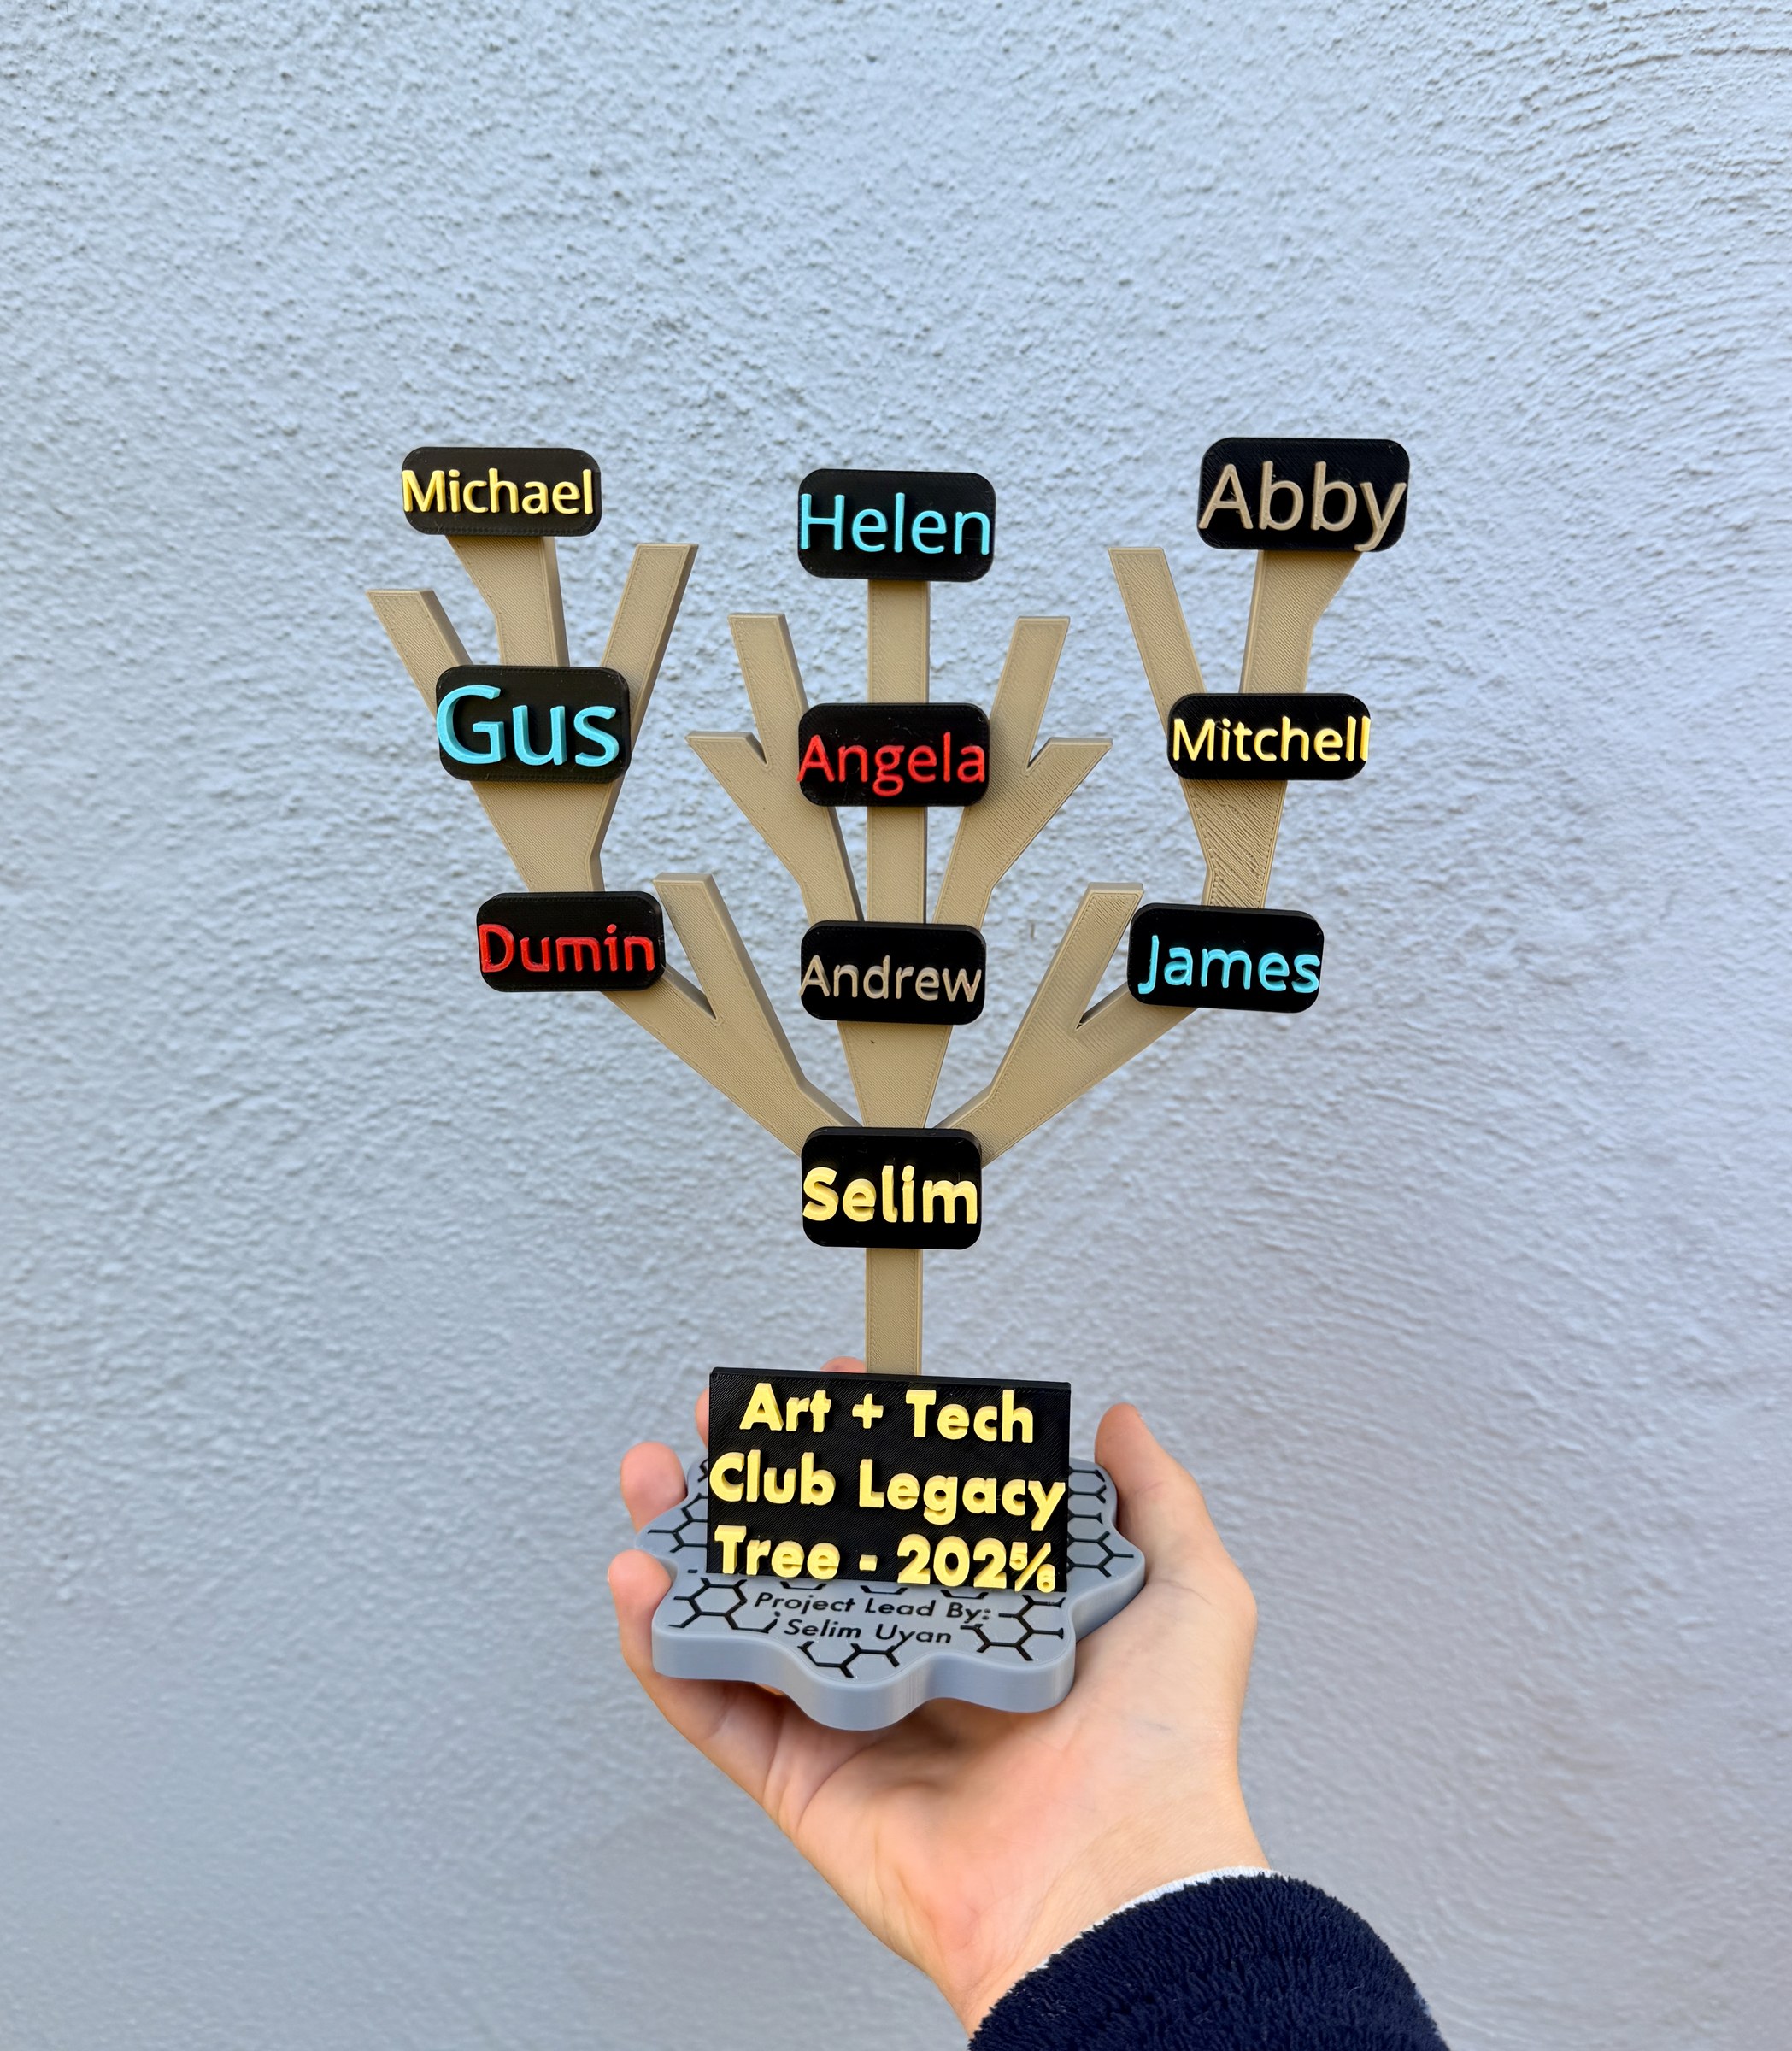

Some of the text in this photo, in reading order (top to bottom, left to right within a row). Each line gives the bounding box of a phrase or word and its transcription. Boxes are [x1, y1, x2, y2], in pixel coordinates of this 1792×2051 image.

[402, 468, 594, 514] Michael
[1198, 461, 1407, 552] Abby
[800, 492, 990, 555] Helen
[437, 685, 620, 767] Gus
[1172, 716, 1371, 762] Mitchell
[796, 732, 985, 796] Angela
[478, 924, 655, 973] Dumin
[1138, 935, 1320, 994] James
[800, 955, 982, 1002] Andrew
[802, 1165, 978, 1224] Selim
[739, 1382, 831, 1433] Art
[906, 1390, 1034, 1443] Tech
[709, 1449, 1066, 1531] Club Legacy
[714, 1525, 841, 1580] Tree
[754, 1592, 991, 1622] Project Lead By:
[784, 1619, 952, 1650] Selim Uyan
